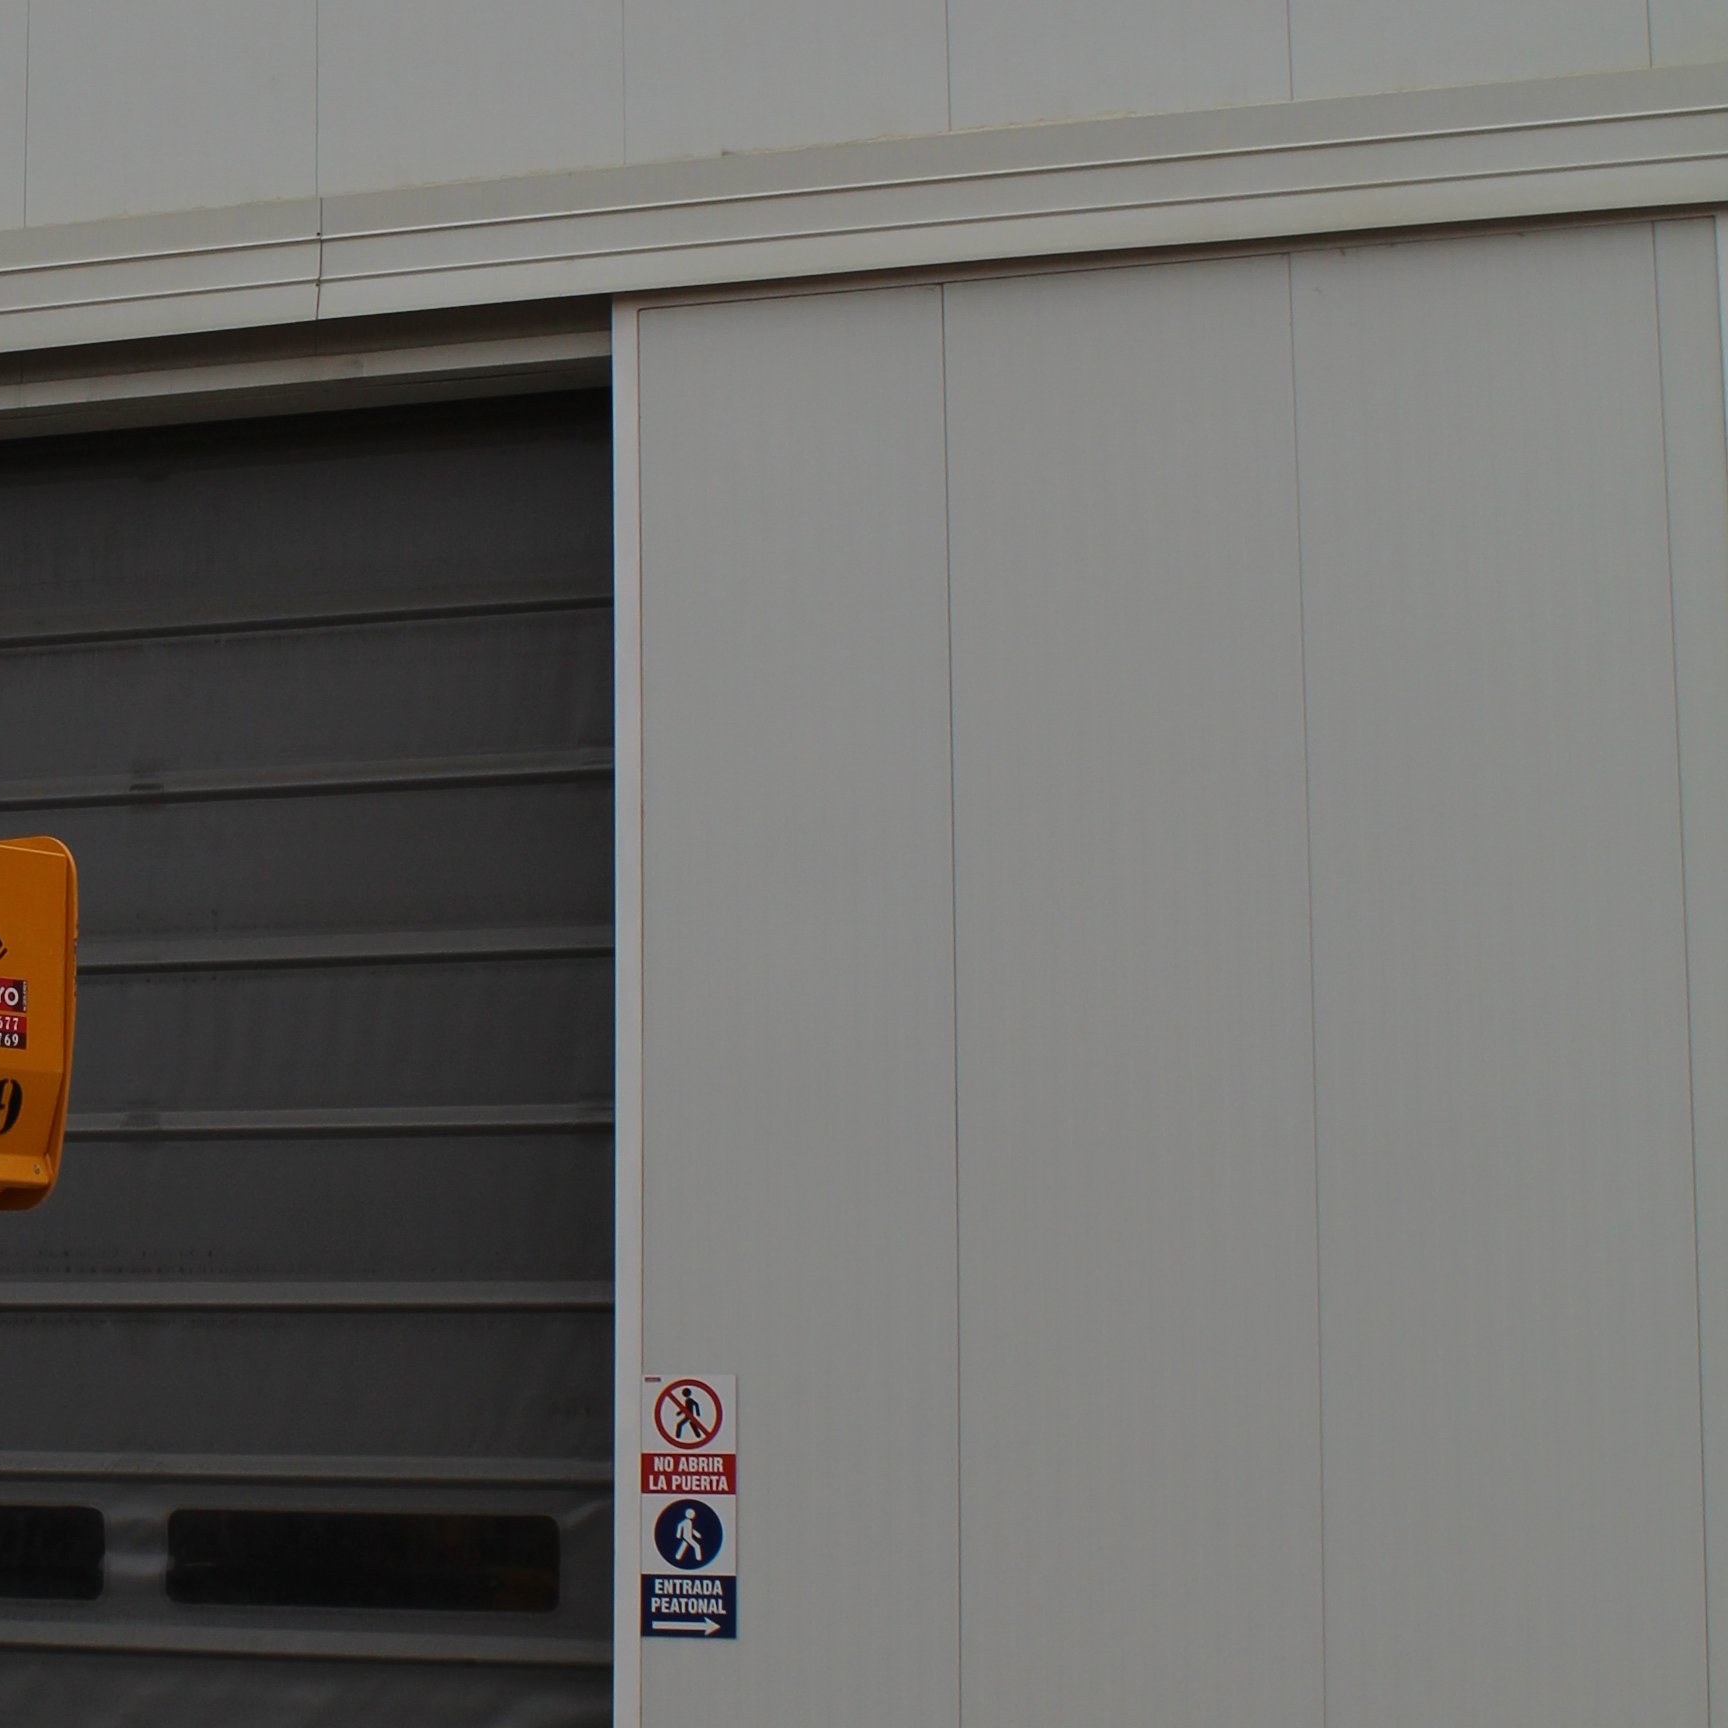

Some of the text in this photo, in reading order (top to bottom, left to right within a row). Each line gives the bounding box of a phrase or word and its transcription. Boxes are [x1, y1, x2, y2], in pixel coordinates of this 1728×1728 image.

[654, 1456, 723, 1473] NO ABRIR
[649, 1475, 729, 1491] LA PUERTA
[654, 1578, 723, 1595] ENTRADA
[651, 1597, 726, 1614] PEATONAL
